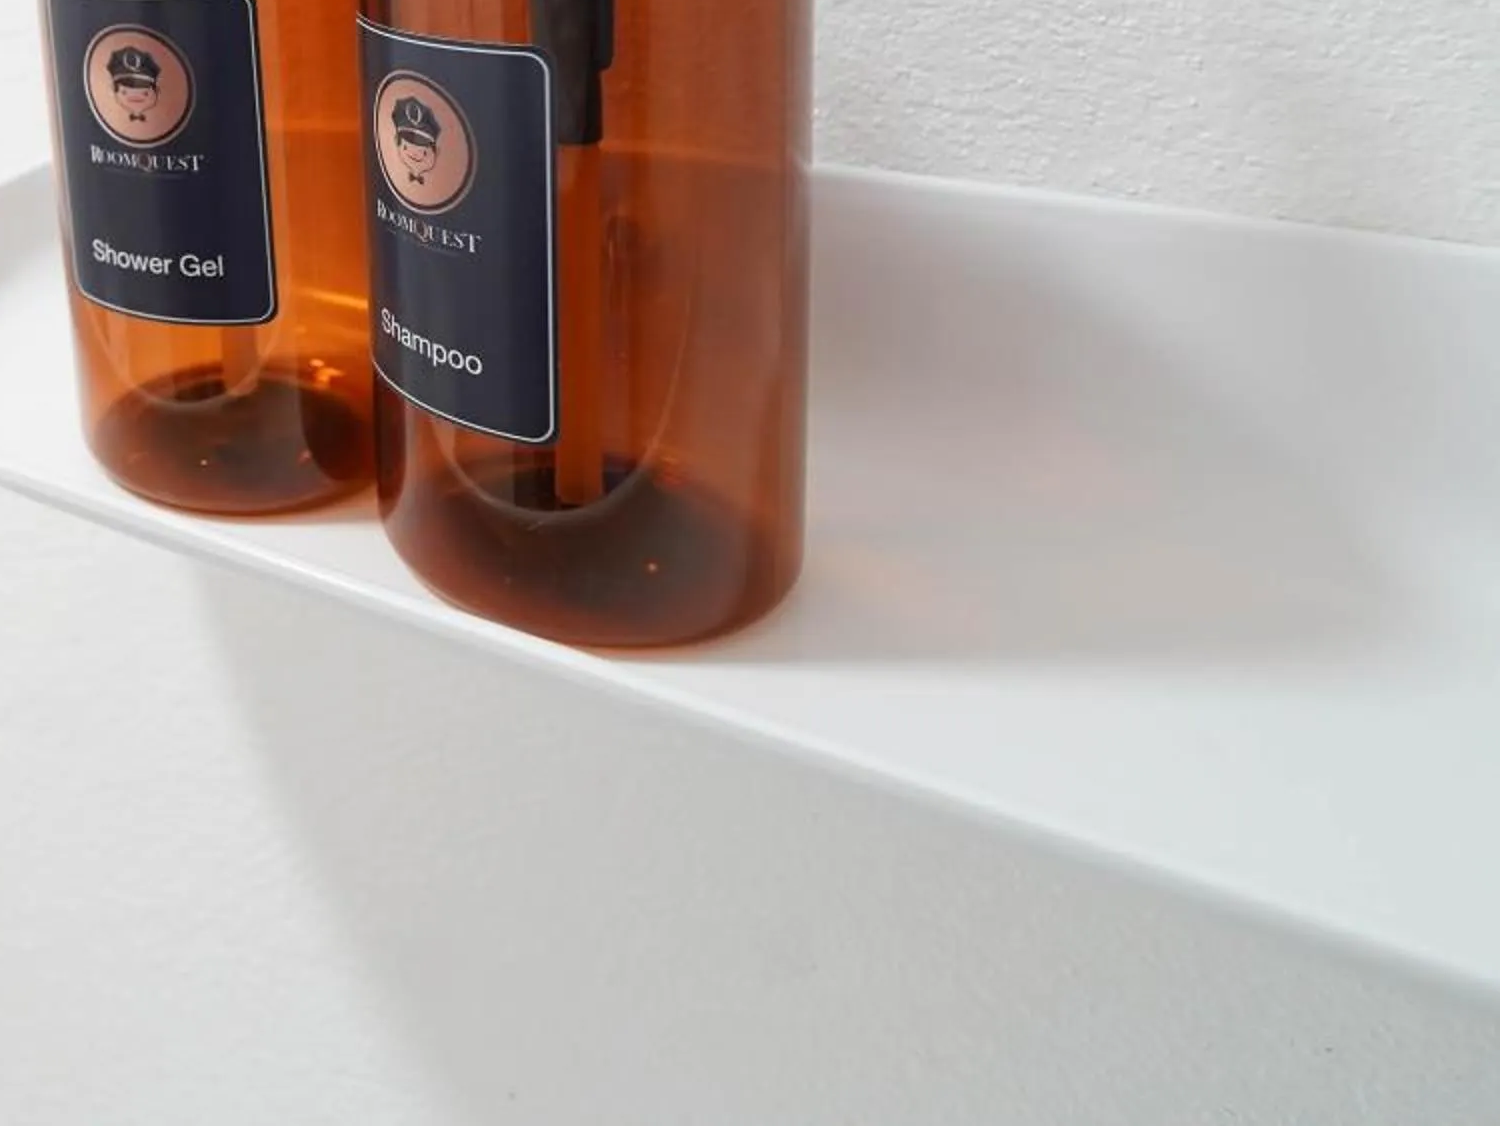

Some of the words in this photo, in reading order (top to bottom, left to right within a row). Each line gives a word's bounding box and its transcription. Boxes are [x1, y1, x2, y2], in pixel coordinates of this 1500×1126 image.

[92, 238, 173, 275] Shower
[179, 253, 224, 277] Gel
[380, 306, 483, 375] Shampoo
